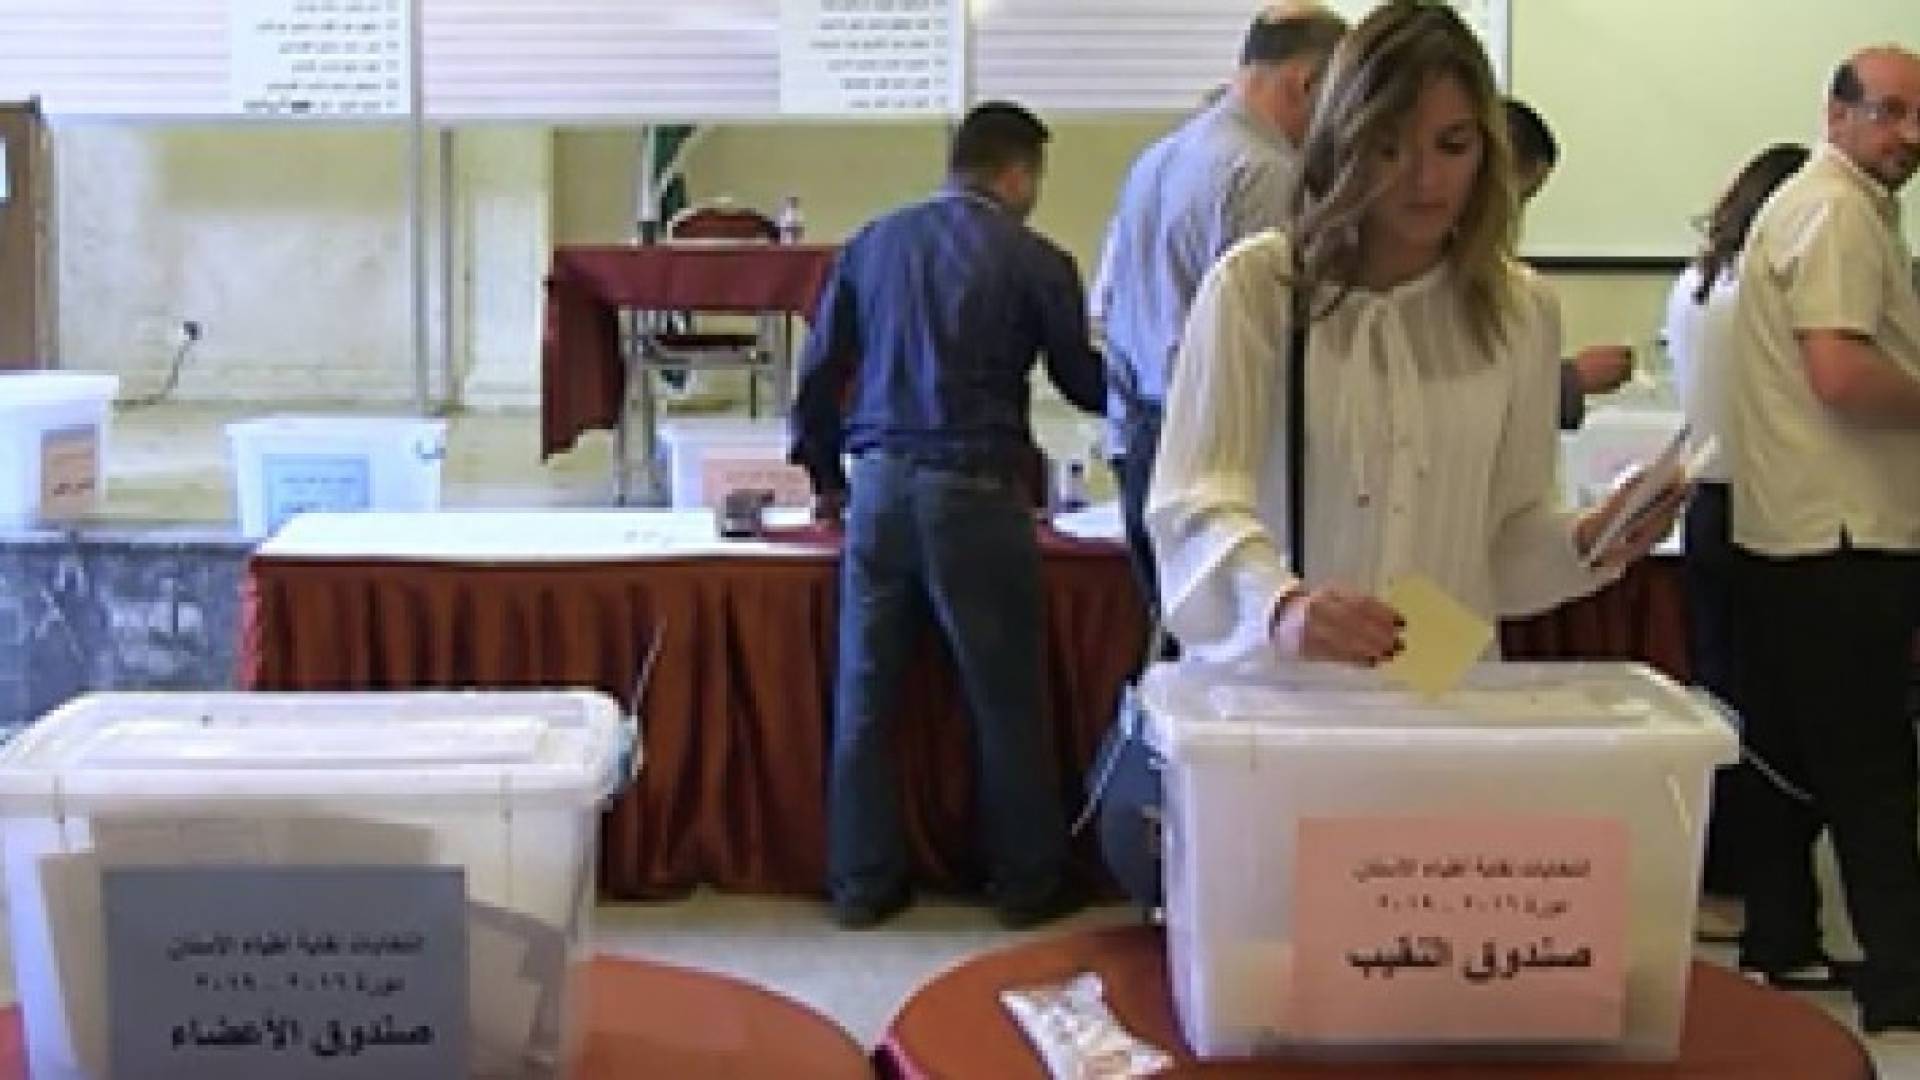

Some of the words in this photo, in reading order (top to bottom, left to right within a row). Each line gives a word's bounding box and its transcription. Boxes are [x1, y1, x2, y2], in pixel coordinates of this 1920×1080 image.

[1346, 934, 1454, 979] النقيب
[1463, 934, 1592, 984] صندوق
[312, 1013, 433, 1057] صندوق
